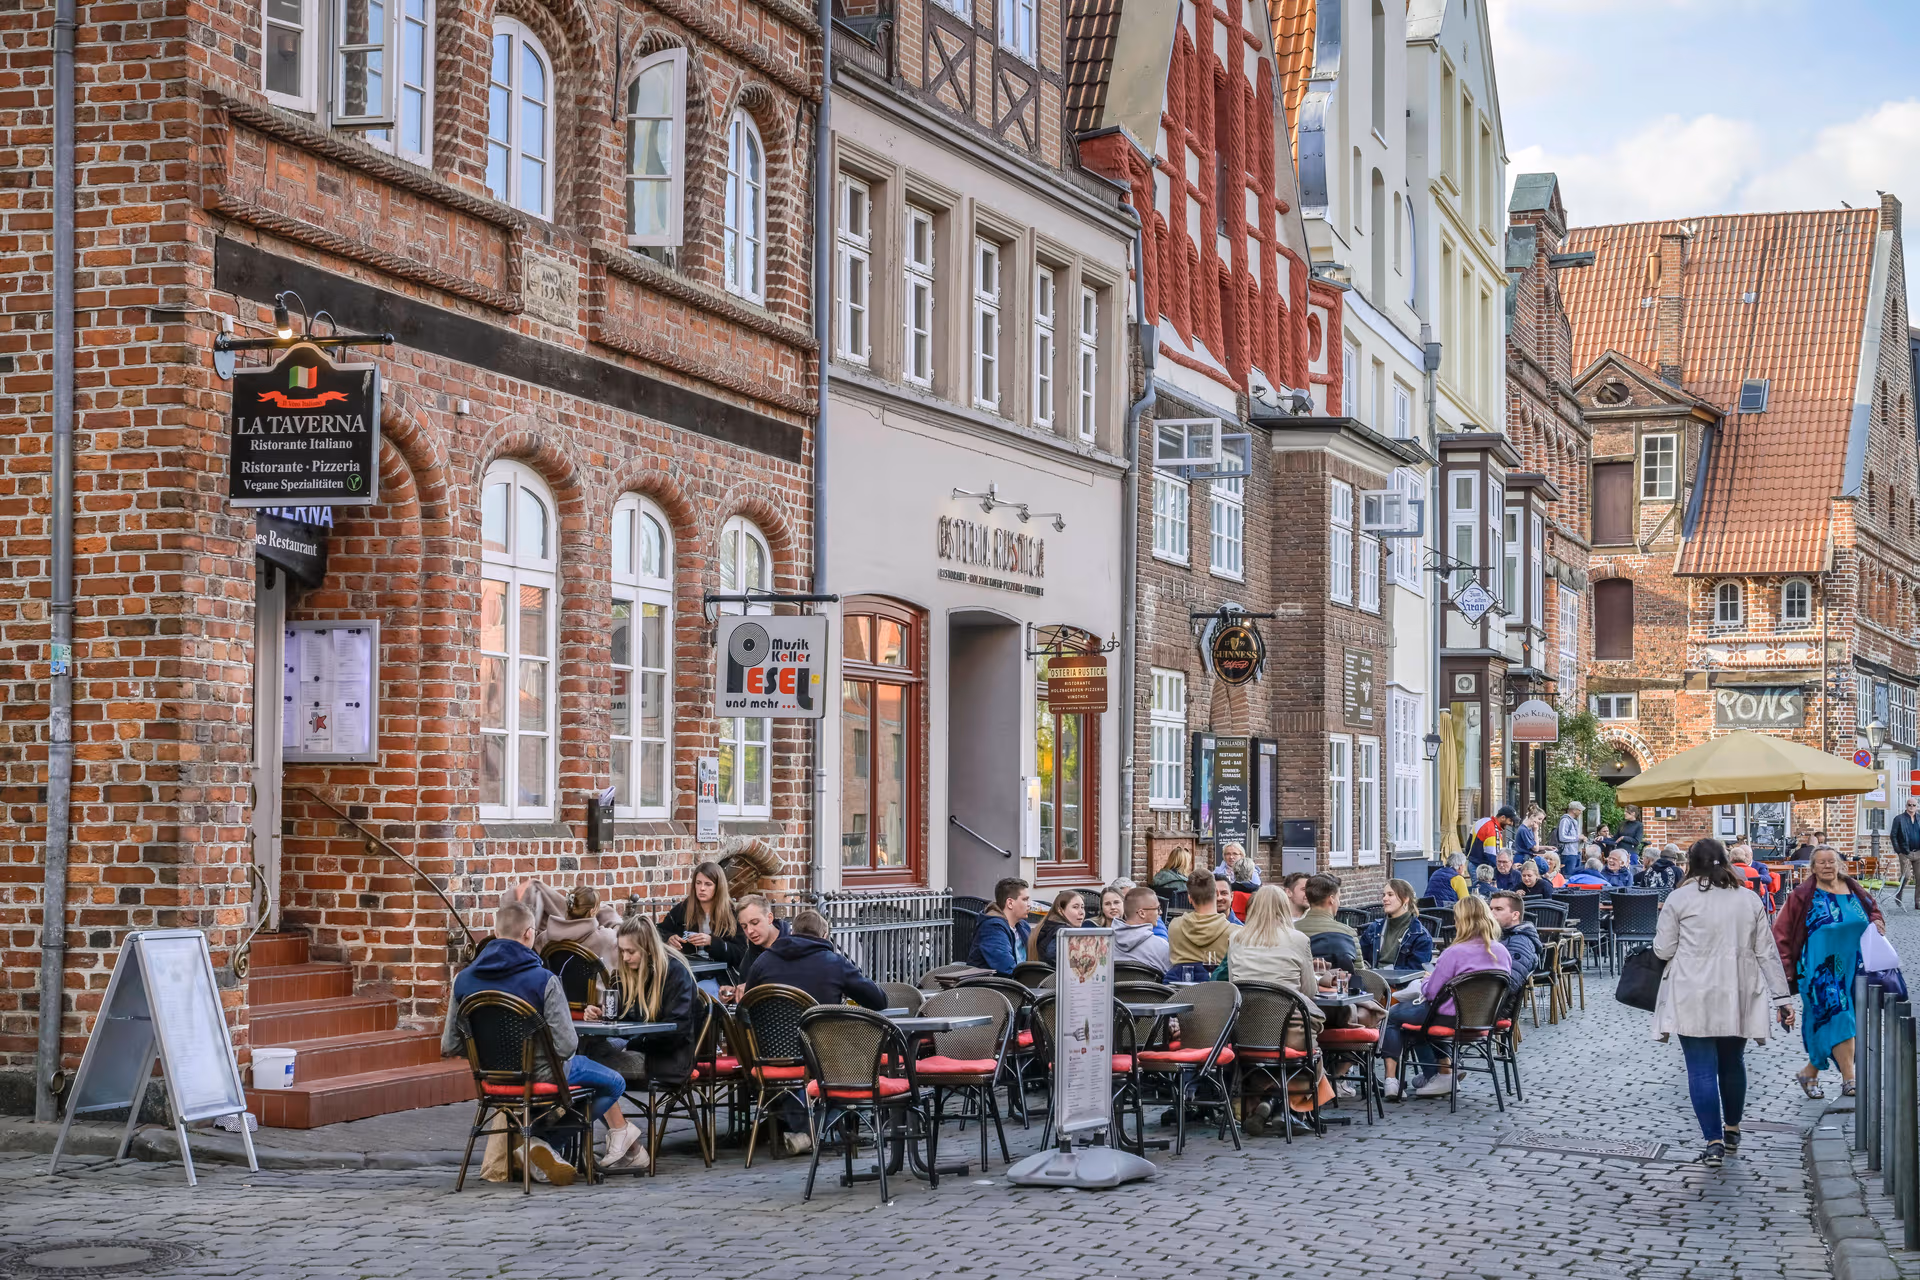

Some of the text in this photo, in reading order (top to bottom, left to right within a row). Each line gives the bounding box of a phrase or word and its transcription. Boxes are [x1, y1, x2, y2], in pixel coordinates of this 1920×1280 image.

[237, 414, 367, 435] LA TAVERNA
[250, 438, 353, 450] Ristorante Italiano
[241, 460, 361, 474] Ristorante Pizzeria
[243, 478, 344, 492] Vegane Spezialitäten
[268, 529, 318, 556] Restaurant
[938, 515, 1045, 578] OSTERIA RUSTICA
[772, 638, 809, 650] Musik
[772, 651, 811, 662] Keller
[1214, 650, 1258, 659] GUINNESS
[725, 698, 747, 708] und
[750, 698, 779, 708] mehr
[1717, 687, 1800, 721] PONS
[1513, 711, 1530, 721] DAS
